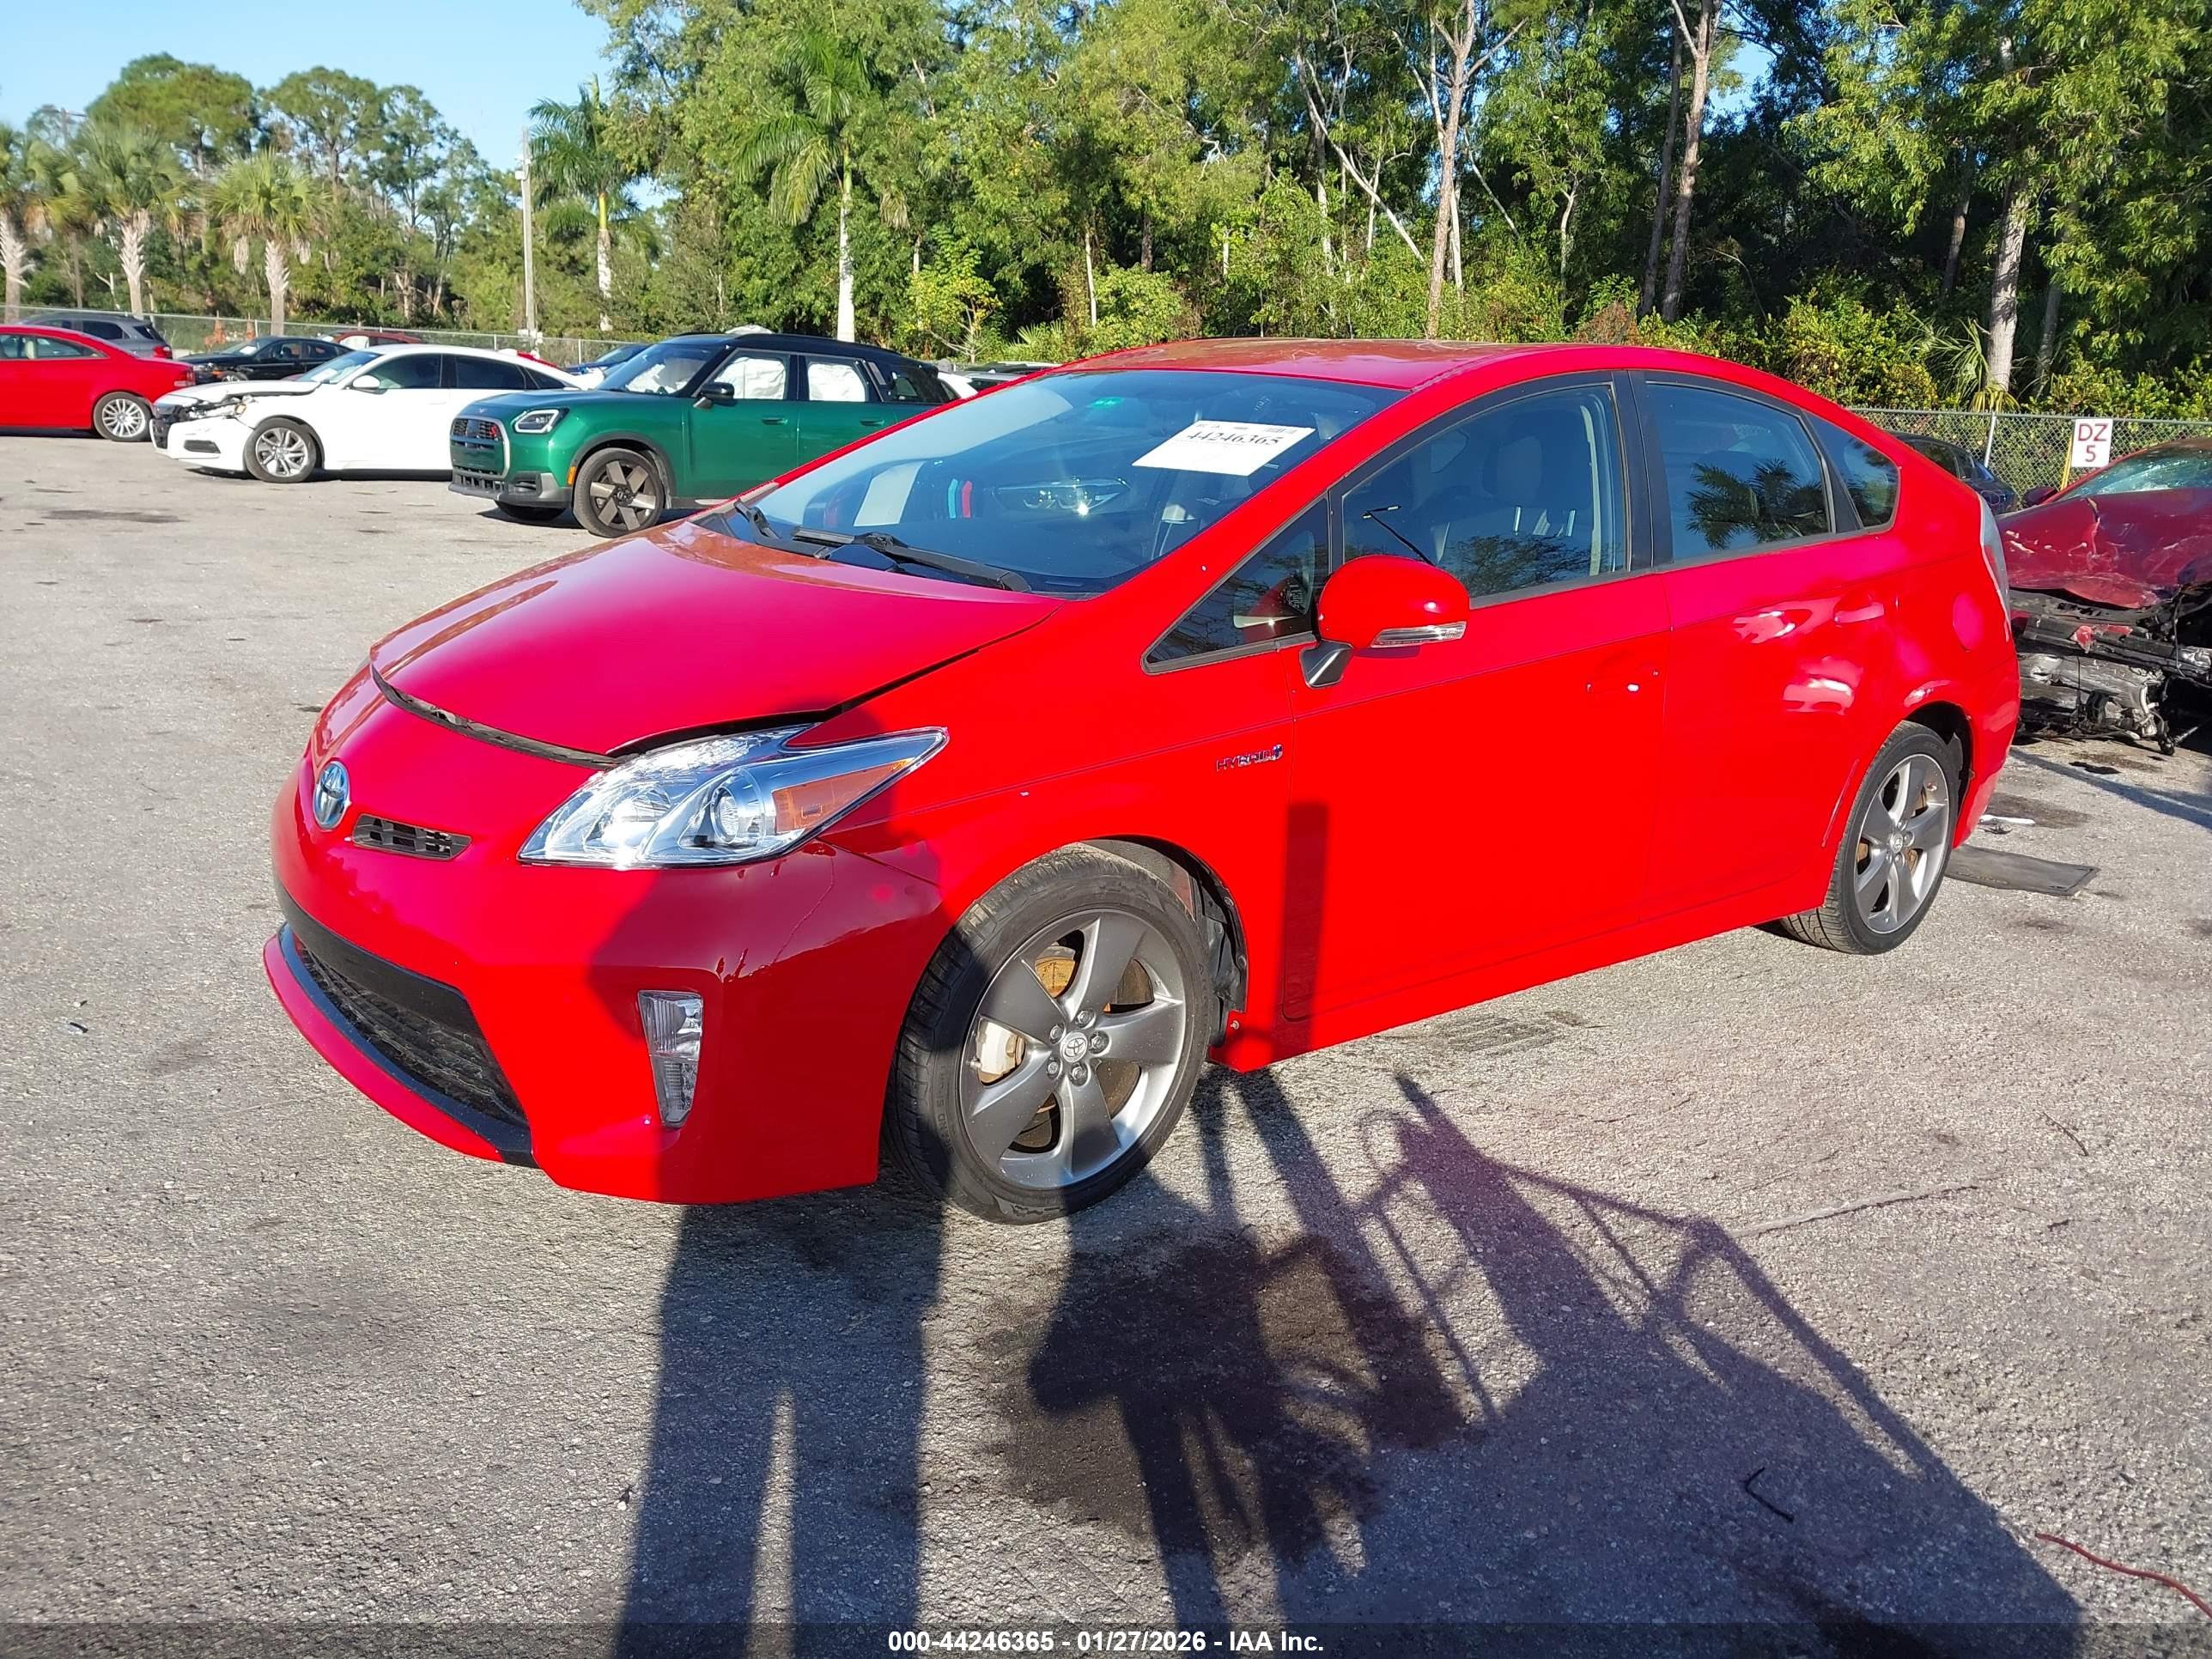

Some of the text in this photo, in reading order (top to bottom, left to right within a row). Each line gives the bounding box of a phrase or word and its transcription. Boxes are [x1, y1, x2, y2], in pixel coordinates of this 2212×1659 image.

[1186, 431, 1285, 446] 44246365
[2077, 422, 2109, 441] DZ
[2084, 444, 2096, 463] 5
[1216, 749, 1276, 771] HYBRID
